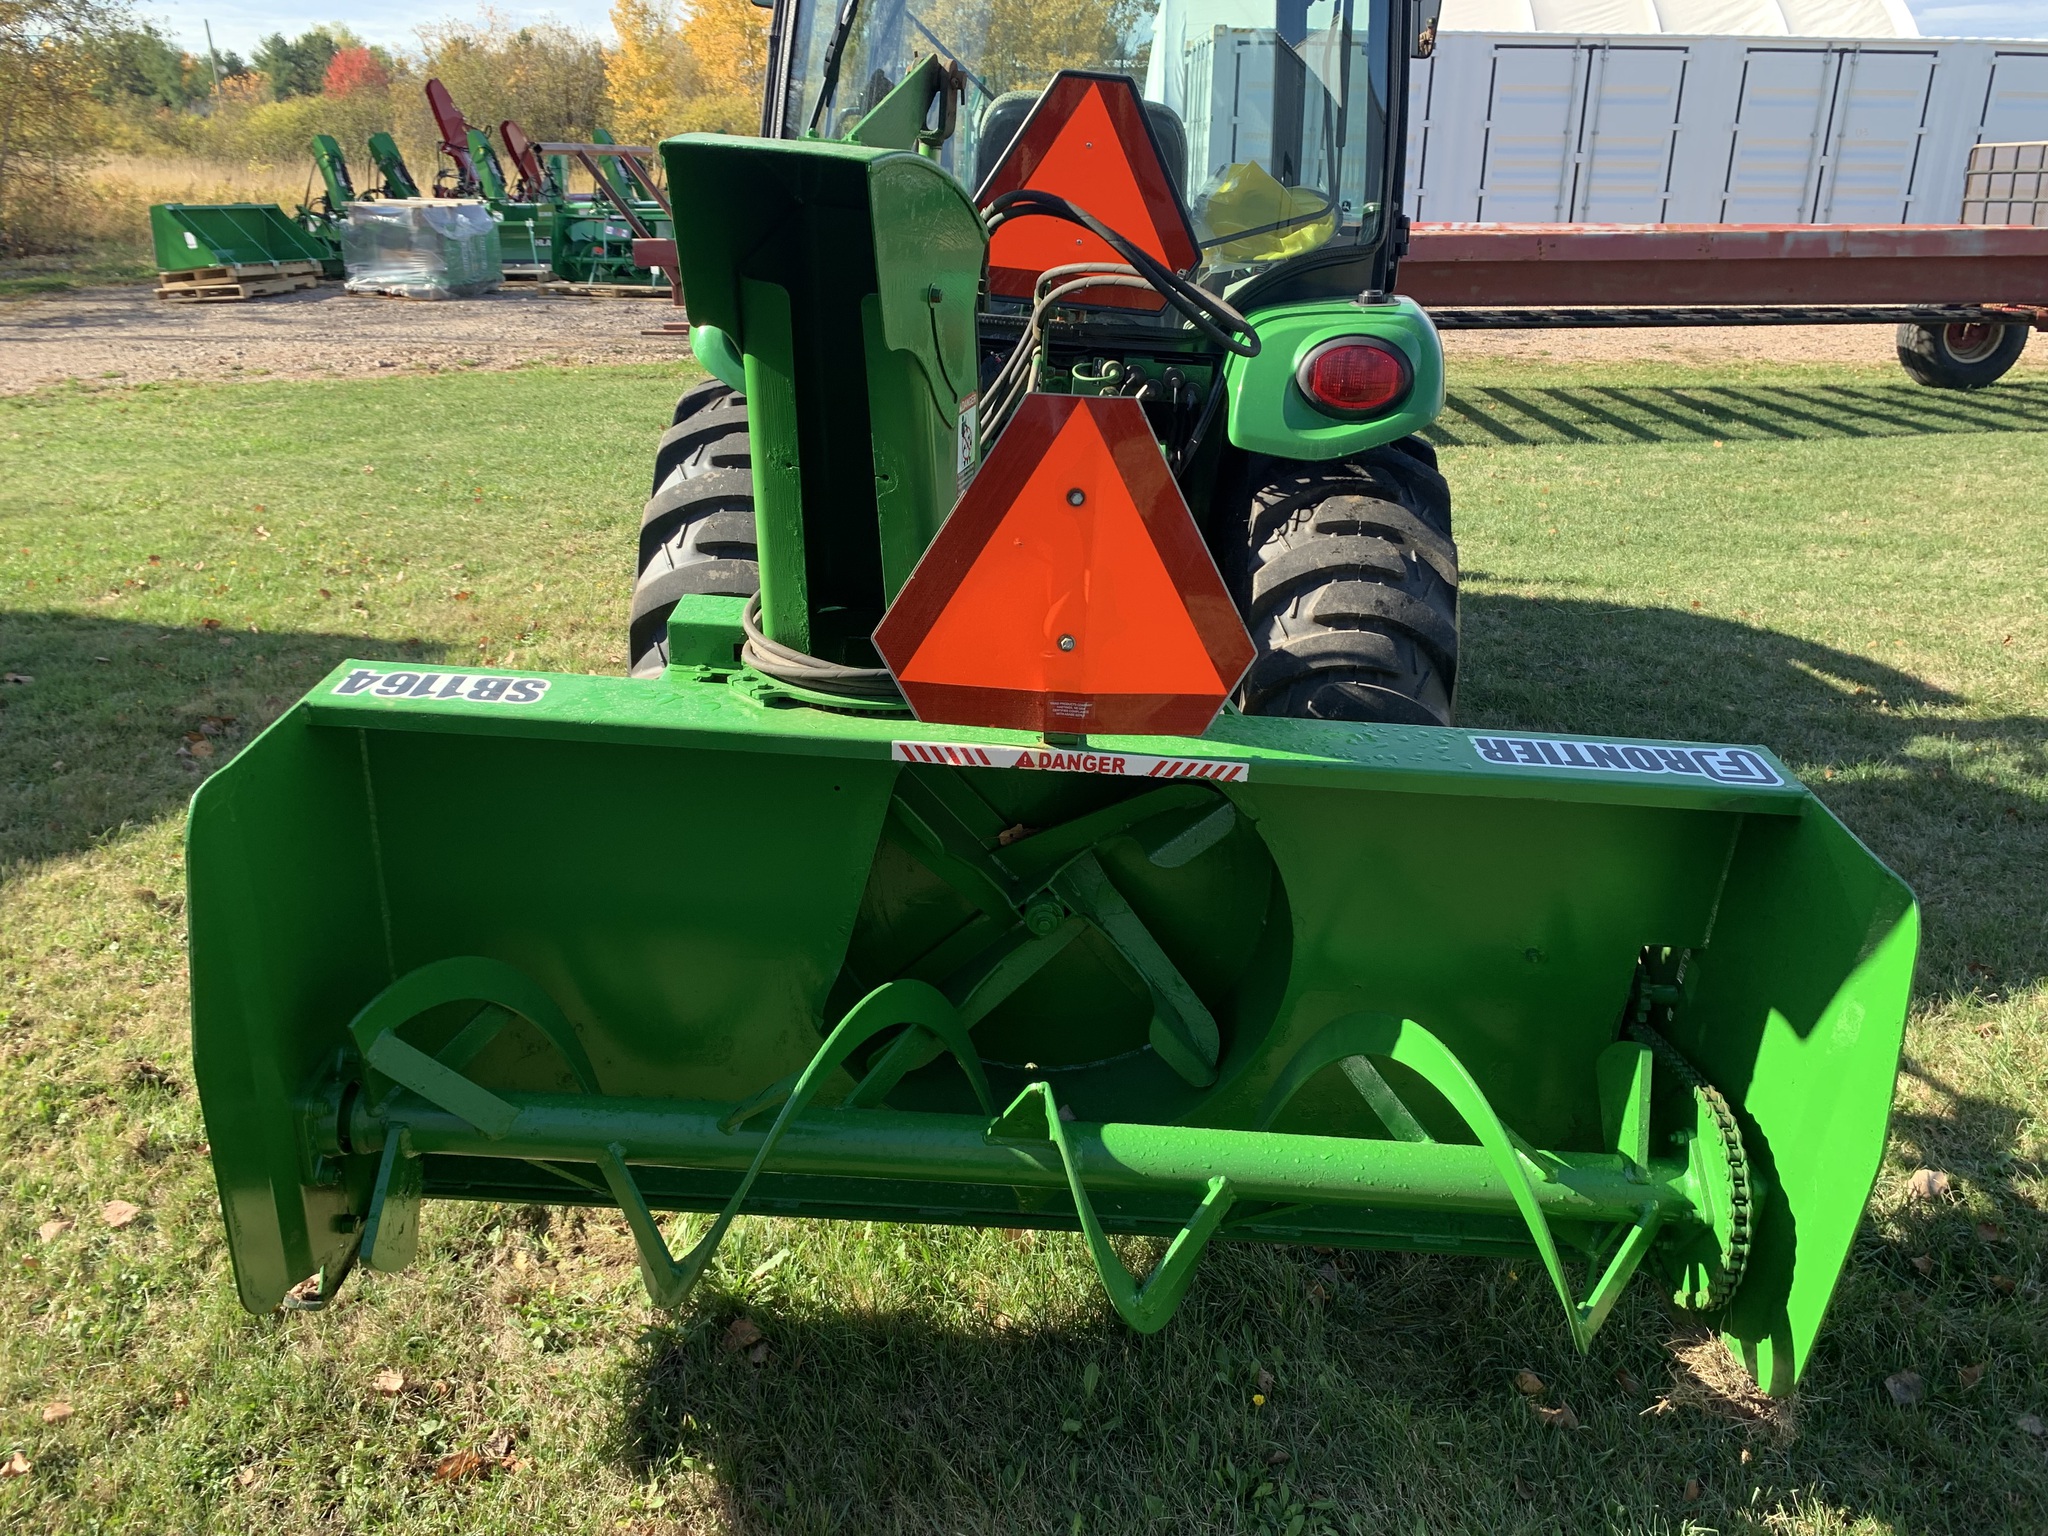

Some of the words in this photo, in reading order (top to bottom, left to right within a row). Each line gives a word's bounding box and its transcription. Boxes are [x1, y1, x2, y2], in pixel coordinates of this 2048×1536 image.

[336, 671, 547, 702] SB1164
[1038, 753, 1126, 773] DANGER
[1473, 738, 1782, 784] FRONTIER
